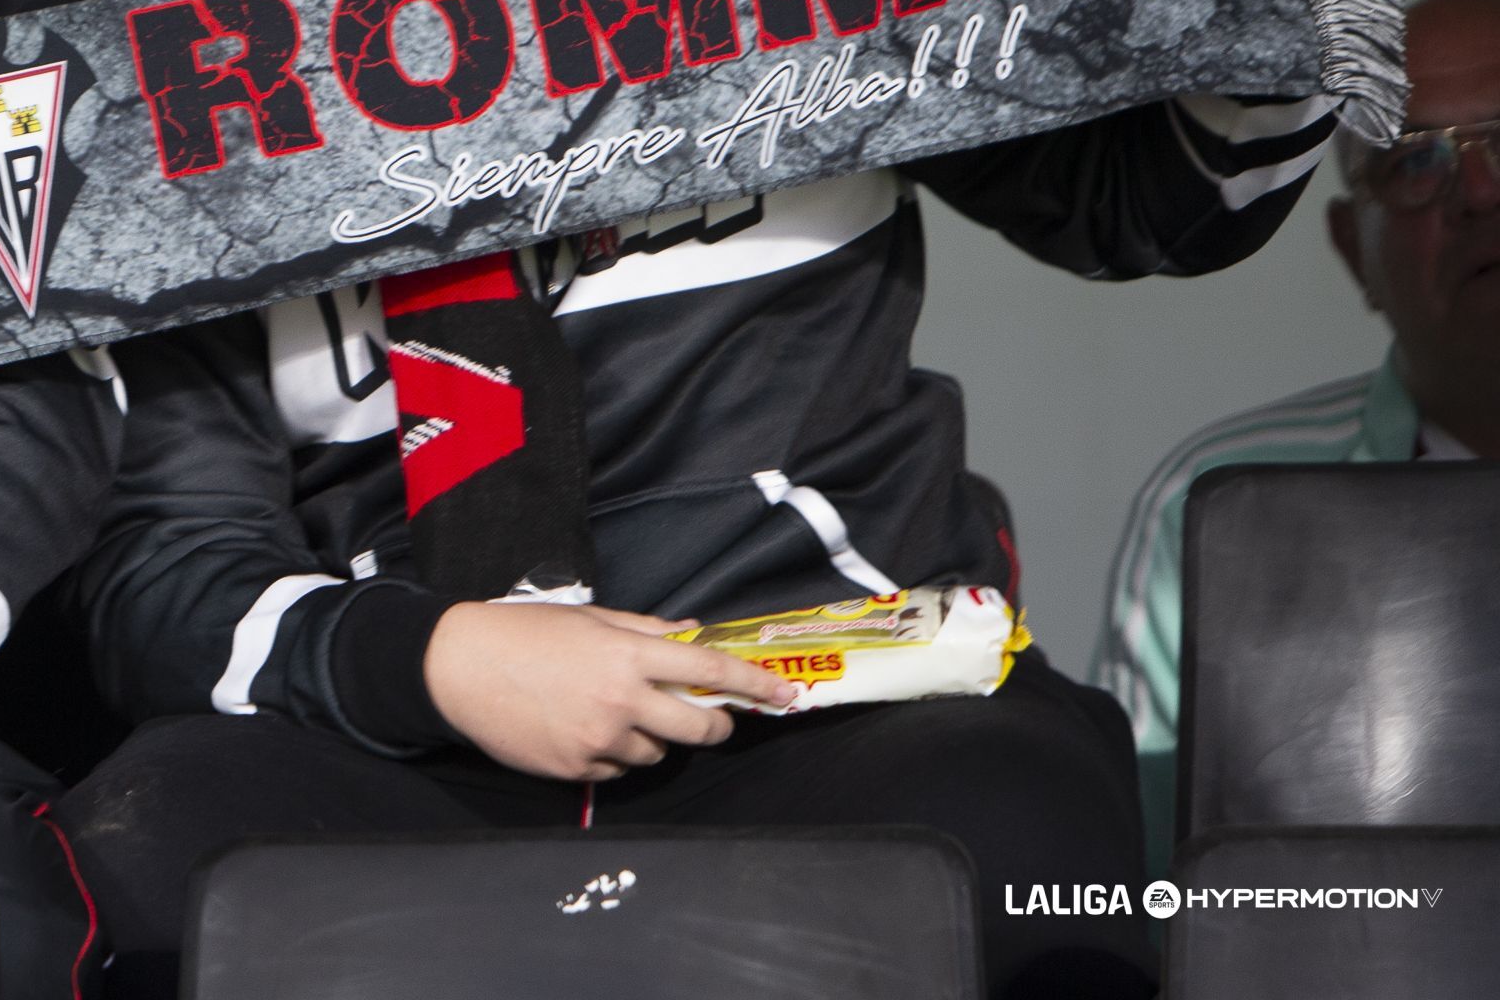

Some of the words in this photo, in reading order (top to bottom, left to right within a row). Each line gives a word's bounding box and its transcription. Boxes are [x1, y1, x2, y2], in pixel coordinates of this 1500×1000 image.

[330, 125, 688, 244] Siempre
[696, 4, 1027, 170] Alba!!!
[750, 652, 842, 674] ETTES
